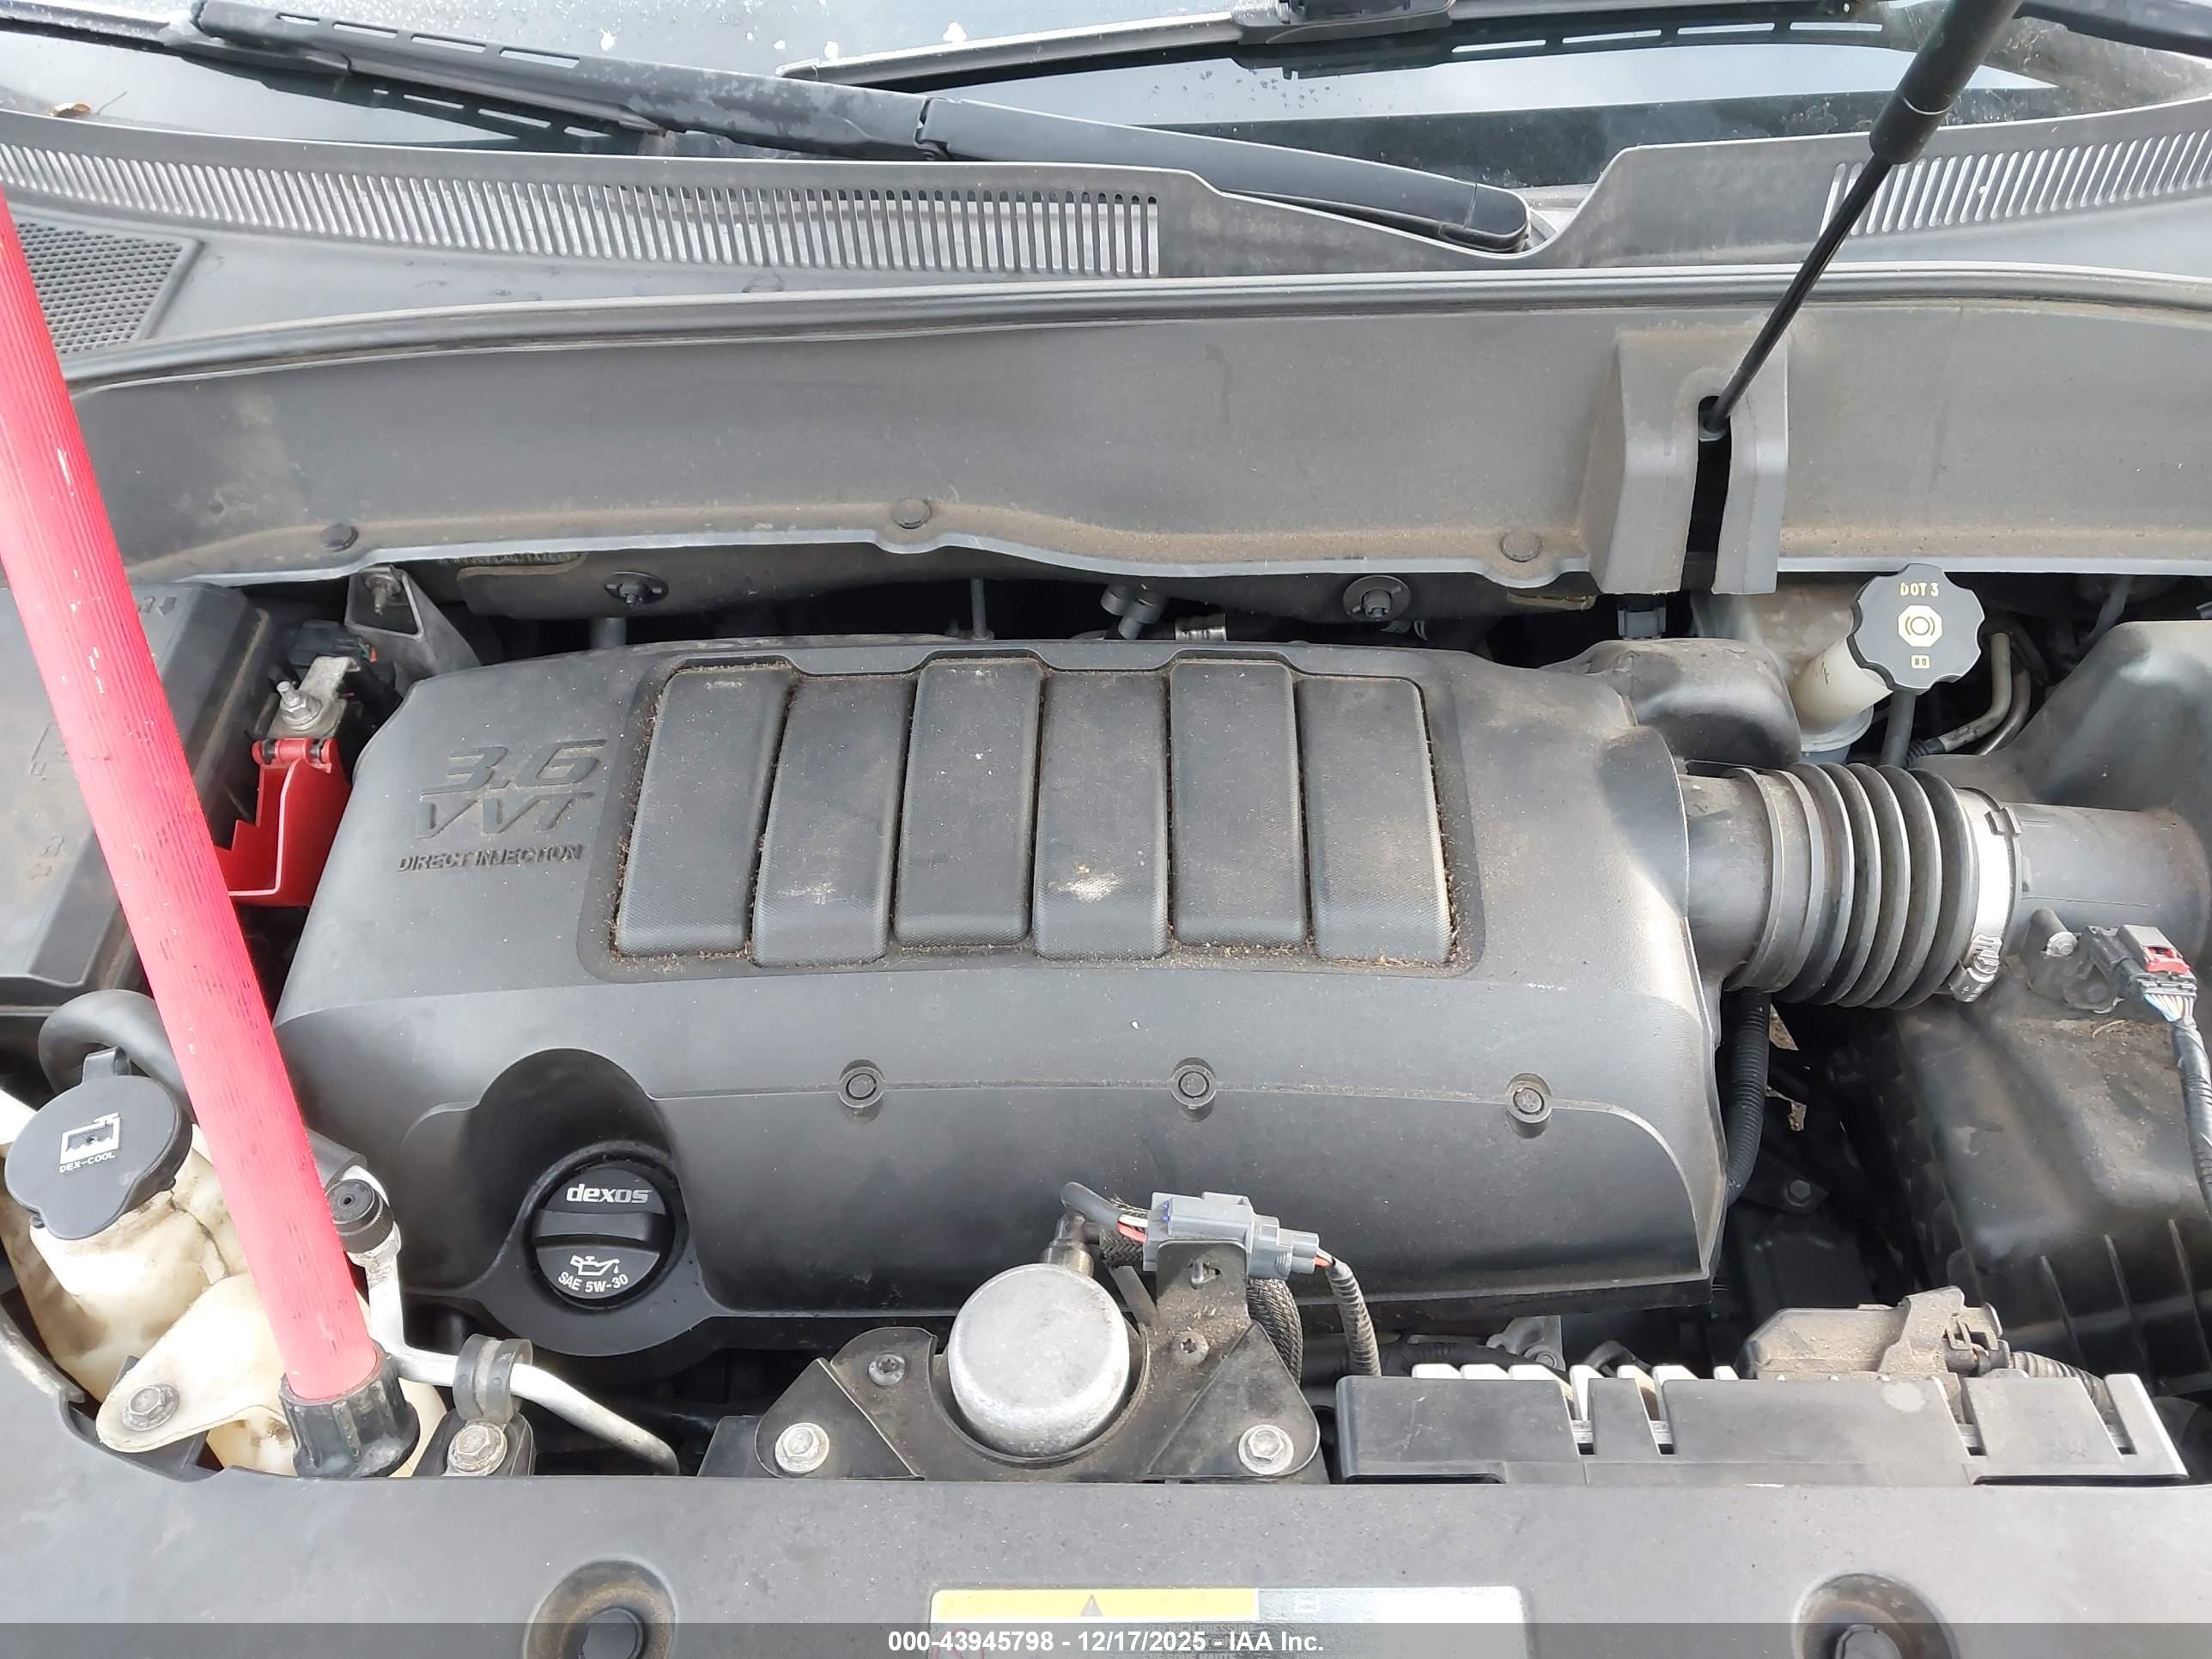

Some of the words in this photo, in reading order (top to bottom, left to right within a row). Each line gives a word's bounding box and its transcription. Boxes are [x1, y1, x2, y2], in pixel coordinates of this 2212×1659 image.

[1900, 582, 1927, 596] DOT
[1930, 582, 1939, 597] 3
[421, 738, 607, 796] 3.6
[415, 792, 595, 840] VVT
[398, 852, 473, 872] DIRECT
[475, 843, 584, 866] INJECTION
[59, 1152, 116, 1173] DEX-COOL
[566, 1183, 652, 1204] dexos
[558, 1272, 582, 1291] SAE
[585, 1274, 629, 1292] 5W-30
